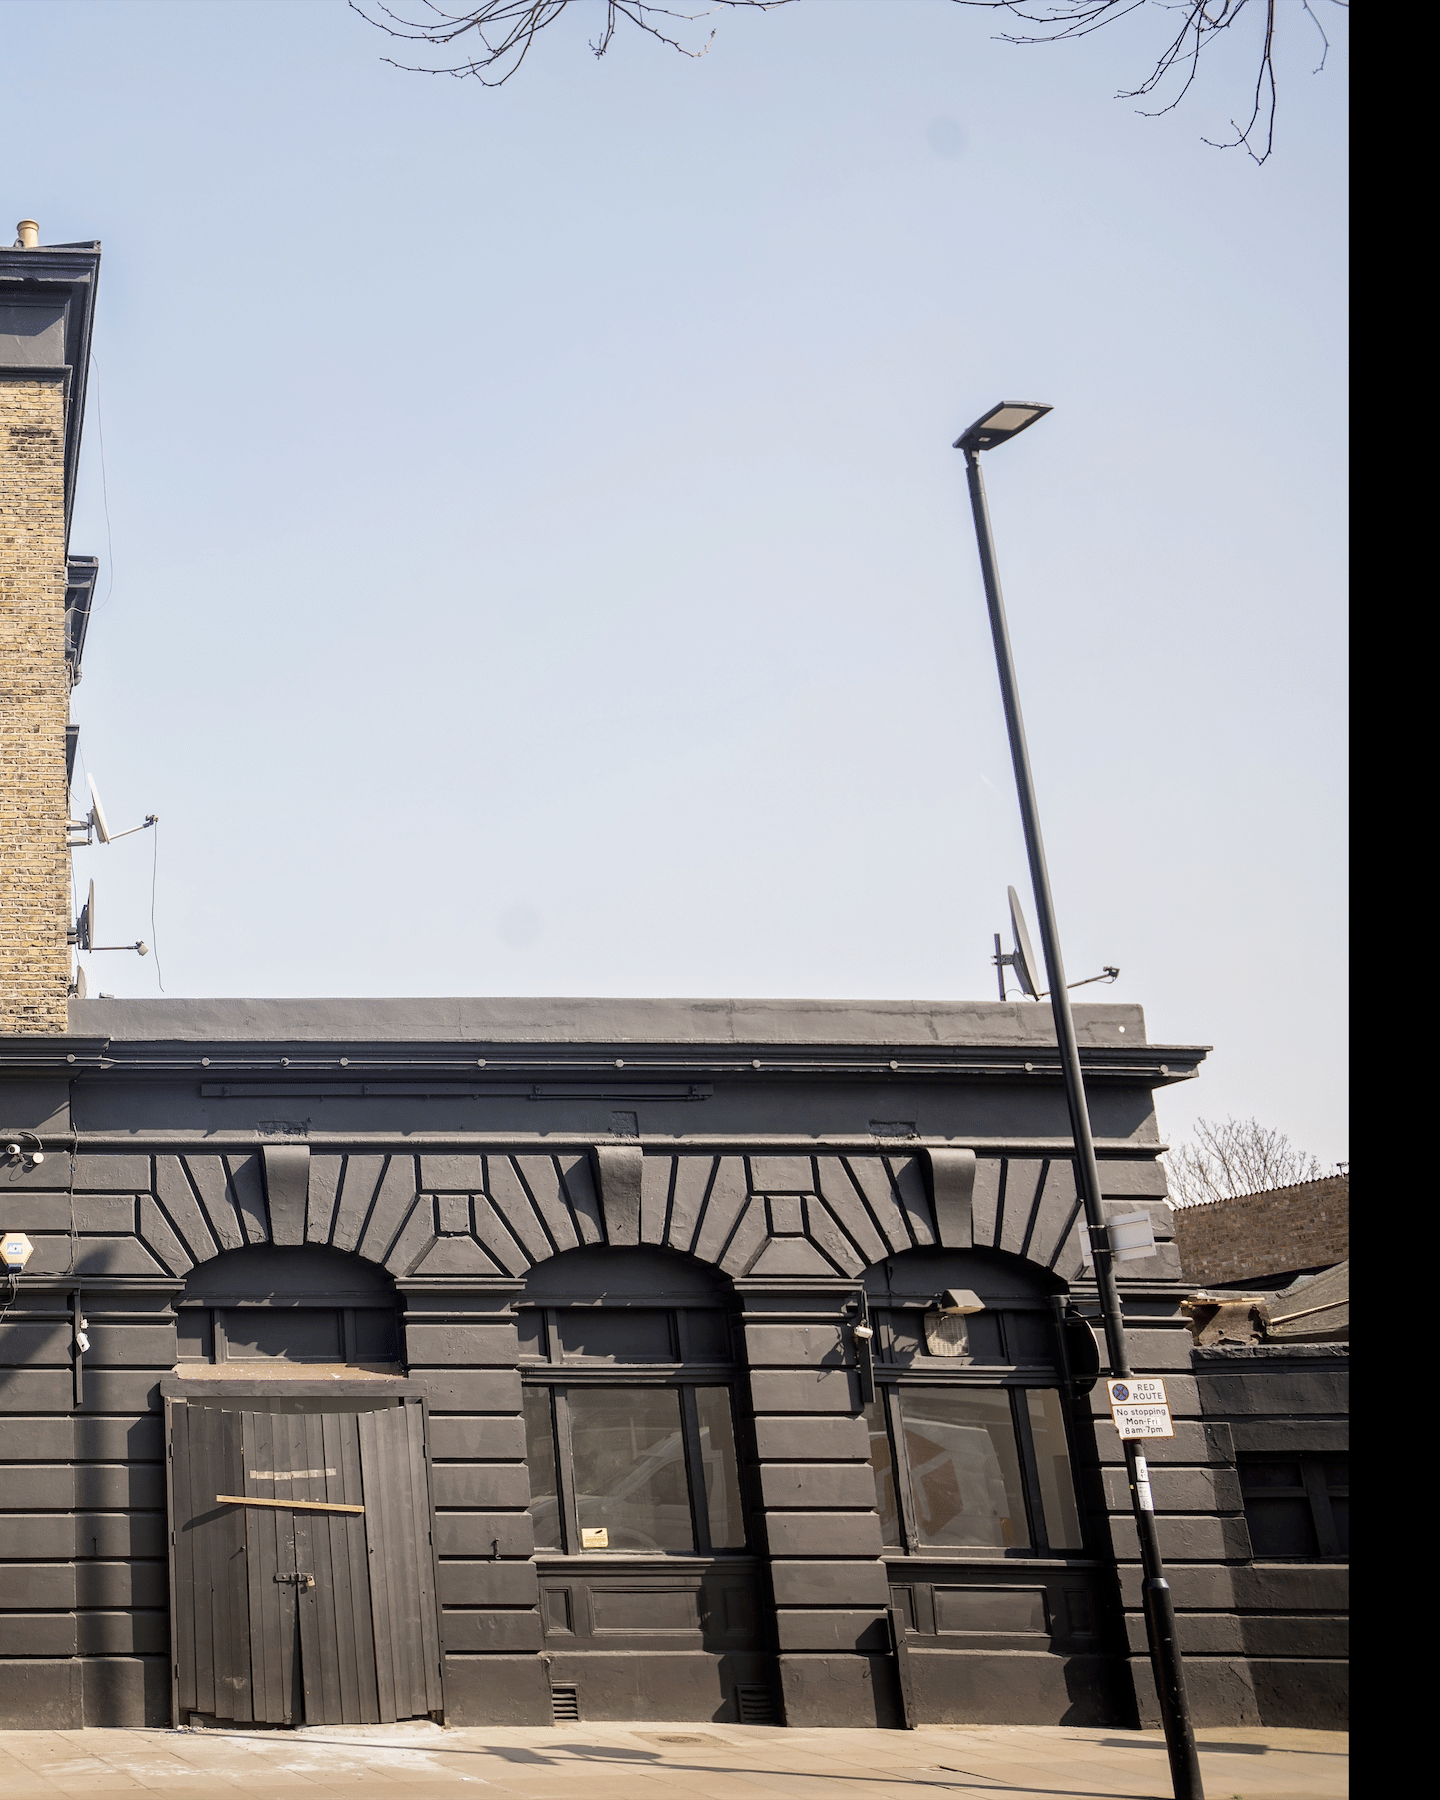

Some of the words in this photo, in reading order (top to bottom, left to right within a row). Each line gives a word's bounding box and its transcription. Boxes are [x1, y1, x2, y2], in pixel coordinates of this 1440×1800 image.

[7, 1244, 23, 1253] ADT
[1131, 1408, 1166, 1416] stopping
[1125, 1426, 1163, 1434] 8am-7pm
